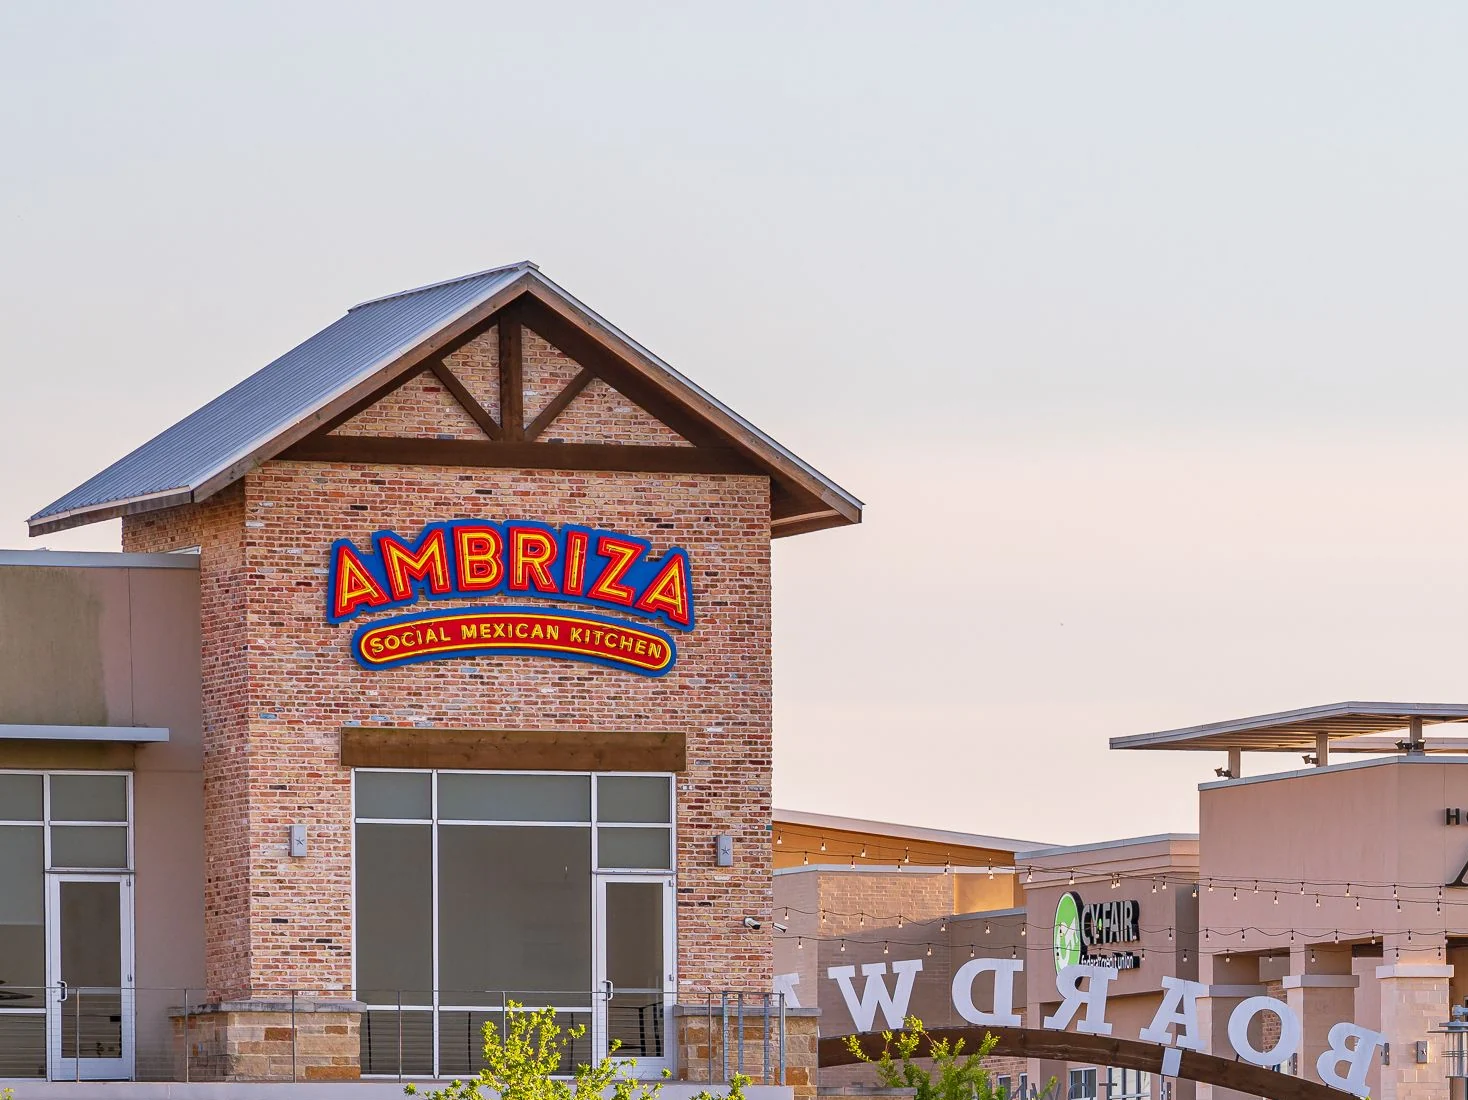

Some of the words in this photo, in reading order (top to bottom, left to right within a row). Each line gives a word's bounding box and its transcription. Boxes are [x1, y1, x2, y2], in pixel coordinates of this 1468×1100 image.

[334, 524, 690, 626] AMBRIZA
[369, 626, 452, 655] SOCIAL
[461, 623, 560, 641] MEXICAN
[570, 627, 662, 660] KITCHEN
[1118, 953, 1133, 969] union
